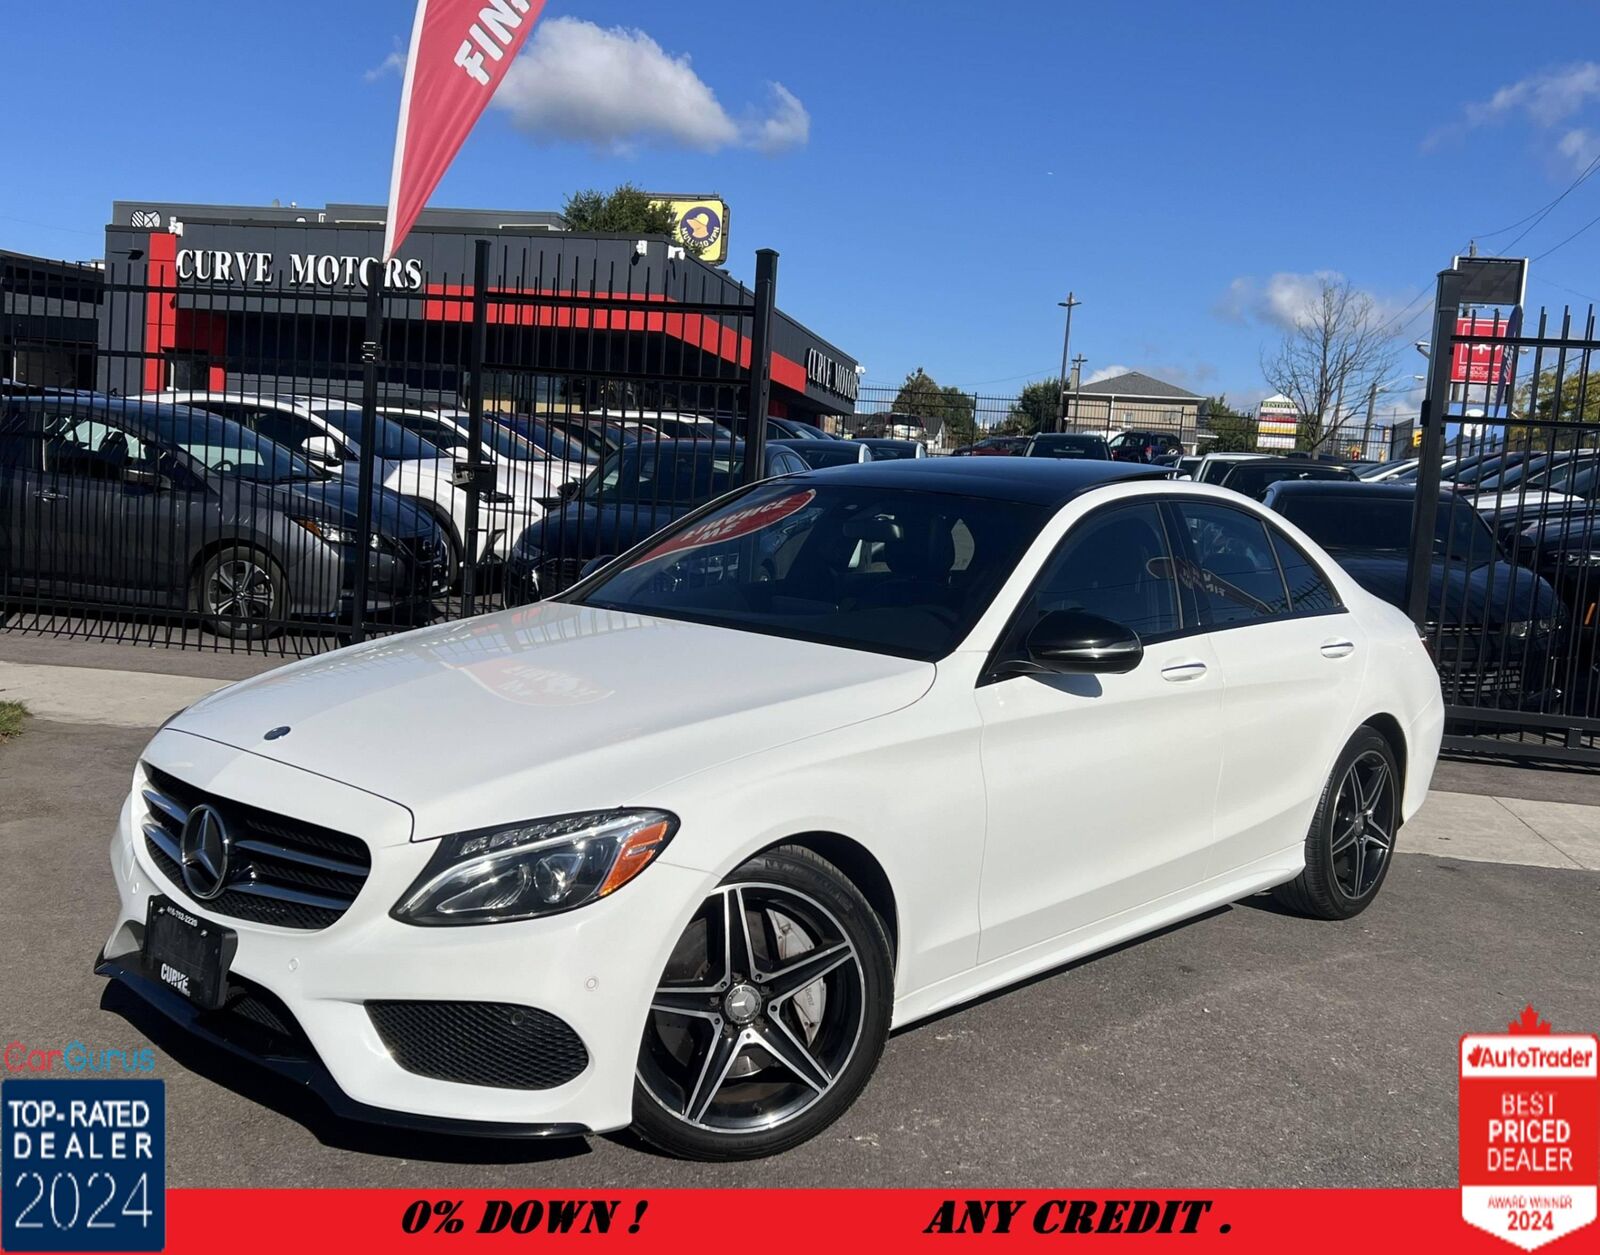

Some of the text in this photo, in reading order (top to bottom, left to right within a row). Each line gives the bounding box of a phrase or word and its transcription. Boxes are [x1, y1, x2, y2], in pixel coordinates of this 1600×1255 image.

[708, 226, 720, 242] VPN
[175, 249, 273, 283] CURVE
[161, 963, 189, 989] CURVE
